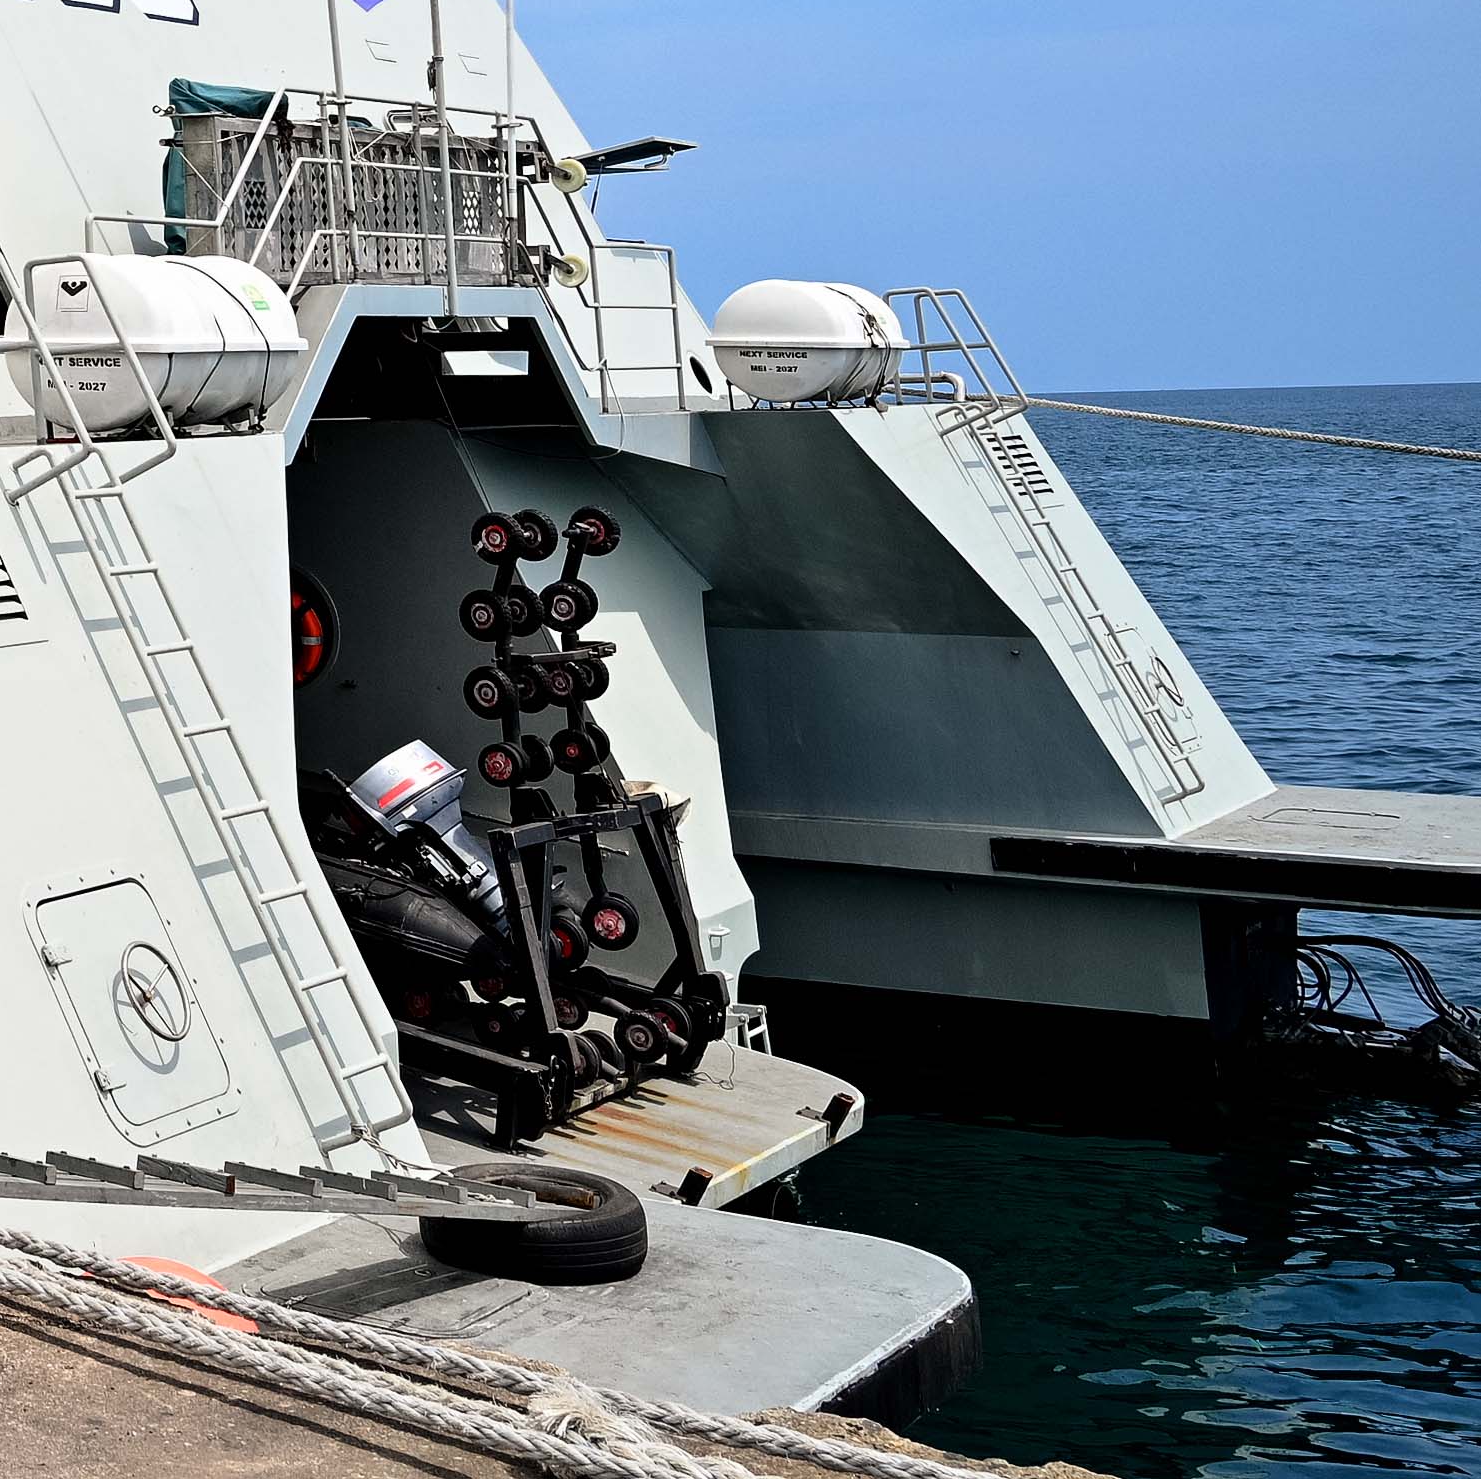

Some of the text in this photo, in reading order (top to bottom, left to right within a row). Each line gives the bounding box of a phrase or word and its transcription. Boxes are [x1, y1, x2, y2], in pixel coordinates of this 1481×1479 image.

[739, 350, 808, 359] NEXT SERVICE
[69, 357, 121, 367] SERVICE
[79, 381, 107, 391] 2027
